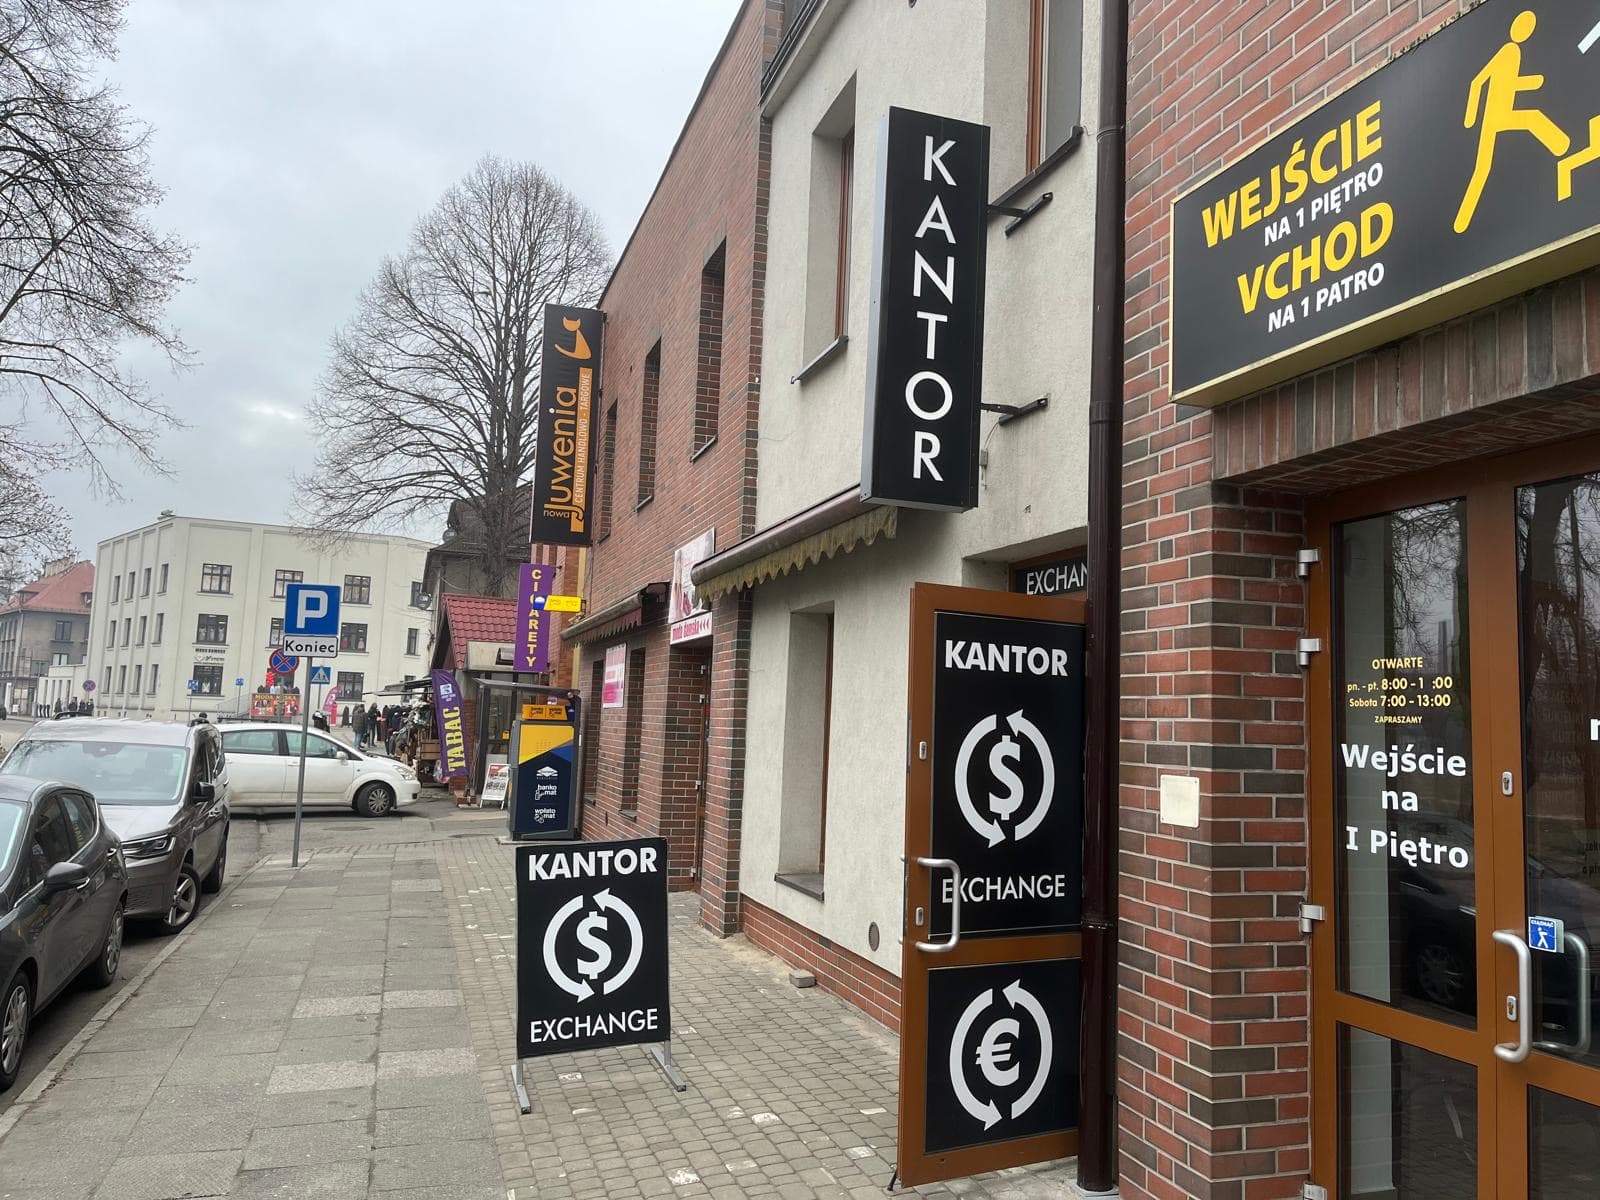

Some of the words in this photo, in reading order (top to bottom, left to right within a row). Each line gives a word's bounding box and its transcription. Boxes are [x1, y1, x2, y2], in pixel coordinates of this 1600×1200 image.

[1201, 99, 1383, 248] WEJŚCIE
[1264, 219, 1291, 246] NA
[1297, 208, 1306, 228] 1
[1310, 162, 1384, 220] PIĘTRO
[1237, 202, 1394, 314] VCHOD
[904, 135, 957, 482] KANTOR
[1267, 307, 1296, 333] NA
[1300, 299, 1310, 318] 1
[1315, 262, 1385, 312] PATRO
[543, 510, 570, 518] nowa
[296, 589, 329, 629] P
[285, 640, 335, 653] Koniec
[944, 639, 1069, 677] KANTOR
[1371, 656, 1424, 670] OTWARTE
[1347, 683, 1360, 693] pn.
[1381, 678, 1408, 690] 8:00
[1349, 698, 1378, 707] Sobota
[1380, 694, 1406, 707] 7:00
[1416, 693, 1452, 707] 13:00
[1374, 715, 1423, 724] ZAPRASZAMY
[442, 706, 466, 772] TABAC
[1341, 743, 1467, 777] Wejście
[1381, 789, 1419, 812] na
[528, 847, 657, 881] KANTOR
[1370, 829, 1469, 868] Piętro
[942, 874, 1066, 904] EXCHANGE
[530, 1008, 658, 1043] EXCHANGE
